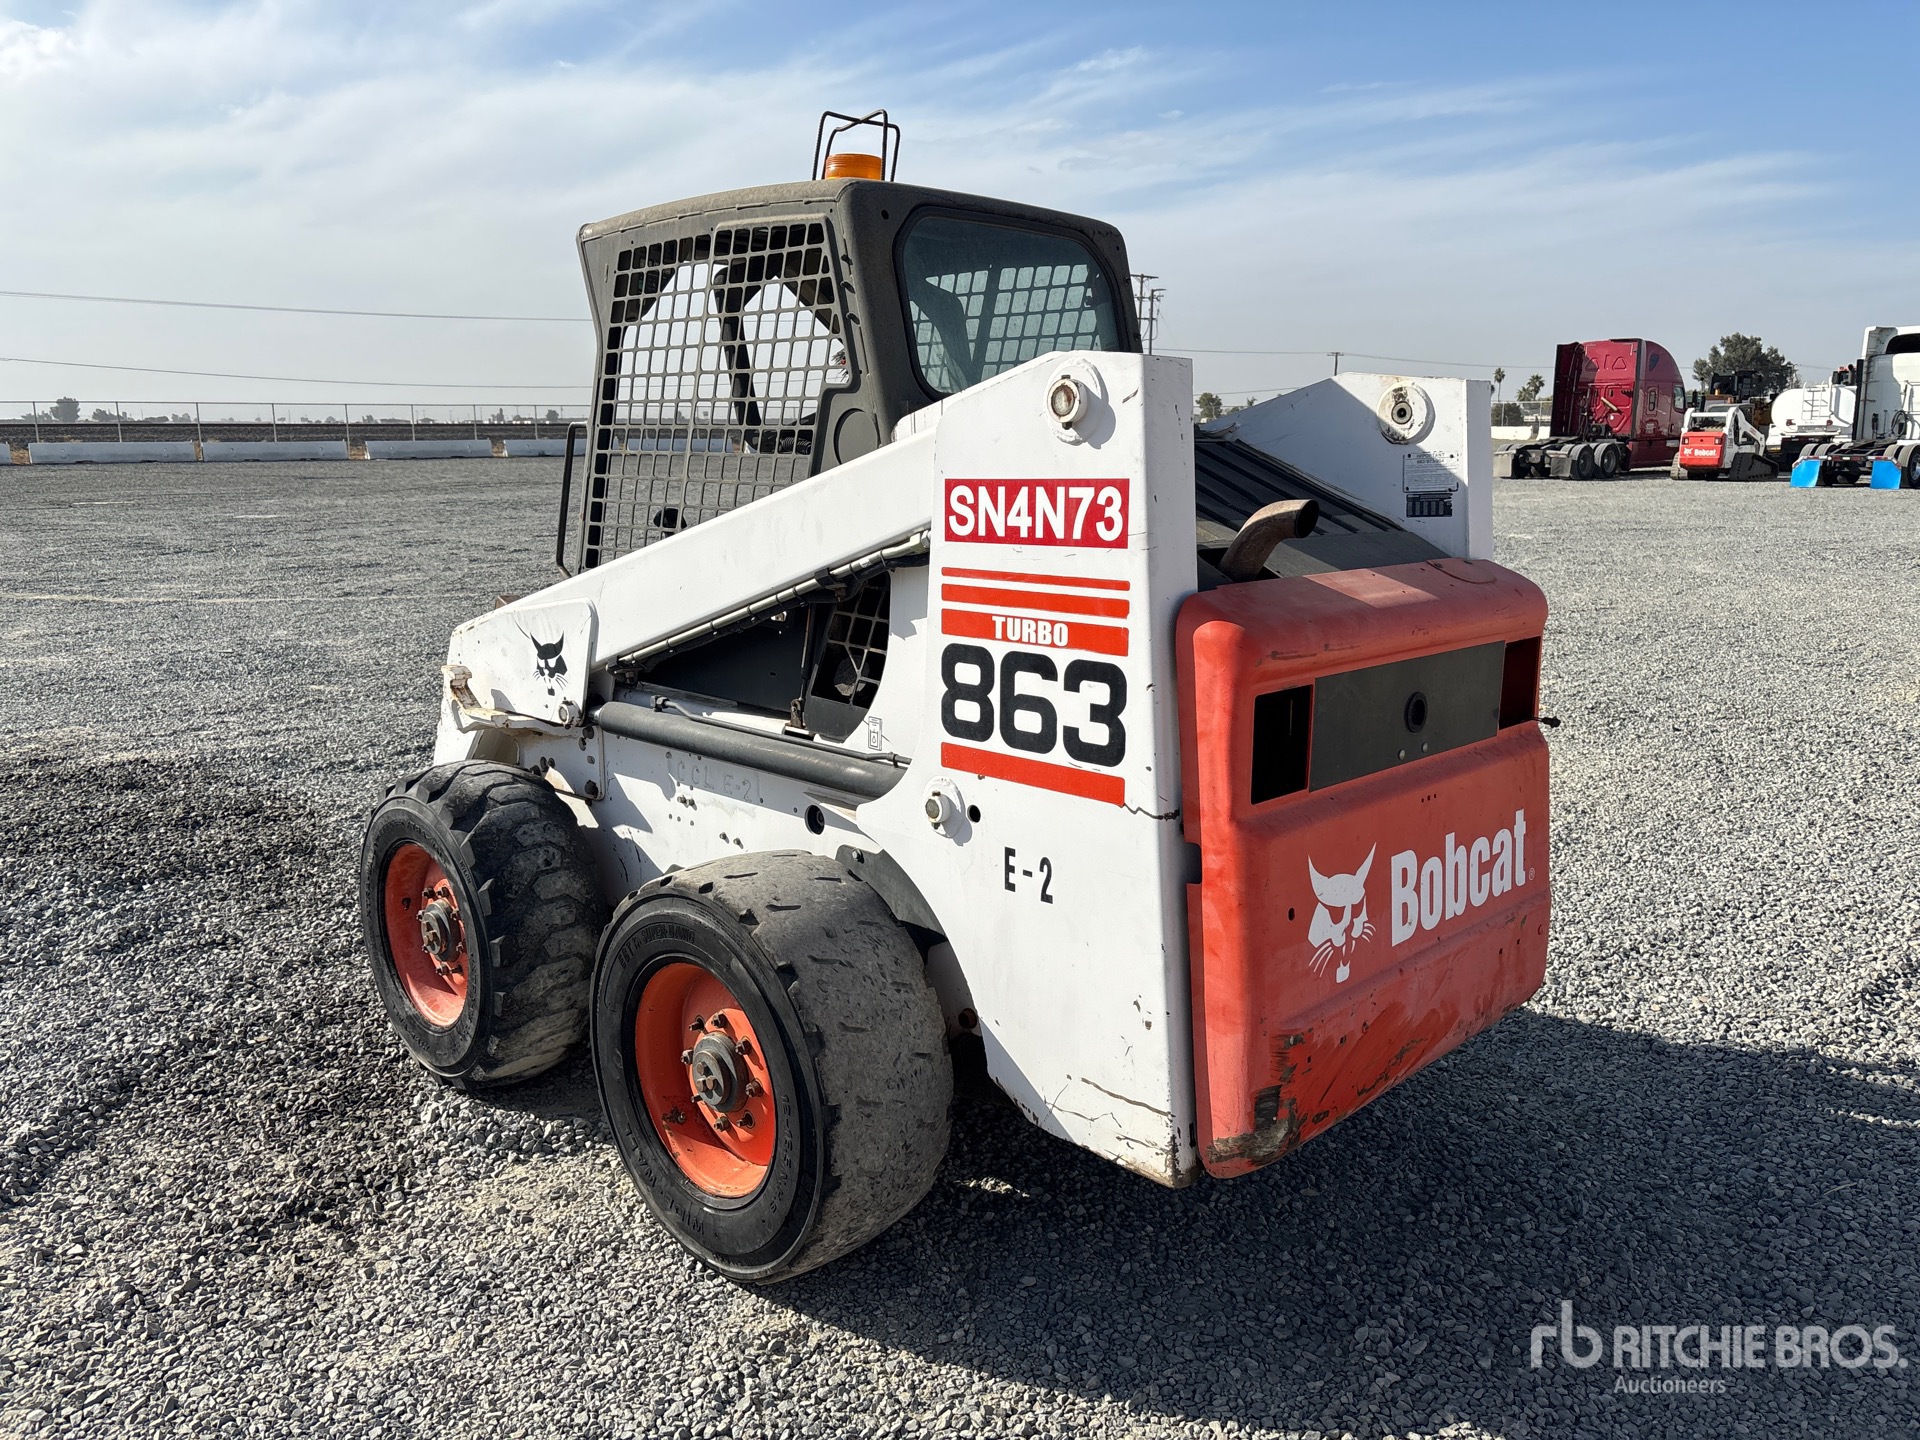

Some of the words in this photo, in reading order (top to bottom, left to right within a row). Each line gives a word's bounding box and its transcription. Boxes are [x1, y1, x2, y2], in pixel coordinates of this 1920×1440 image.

[1694, 448, 1717, 456] Bobcat
[948, 485, 1123, 542] SN4N73
[992, 615, 1069, 647] TURBO
[941, 642, 1127, 768] 863
[1004, 846, 1054, 904] E-2
[1391, 808, 1527, 947] Bobcat
